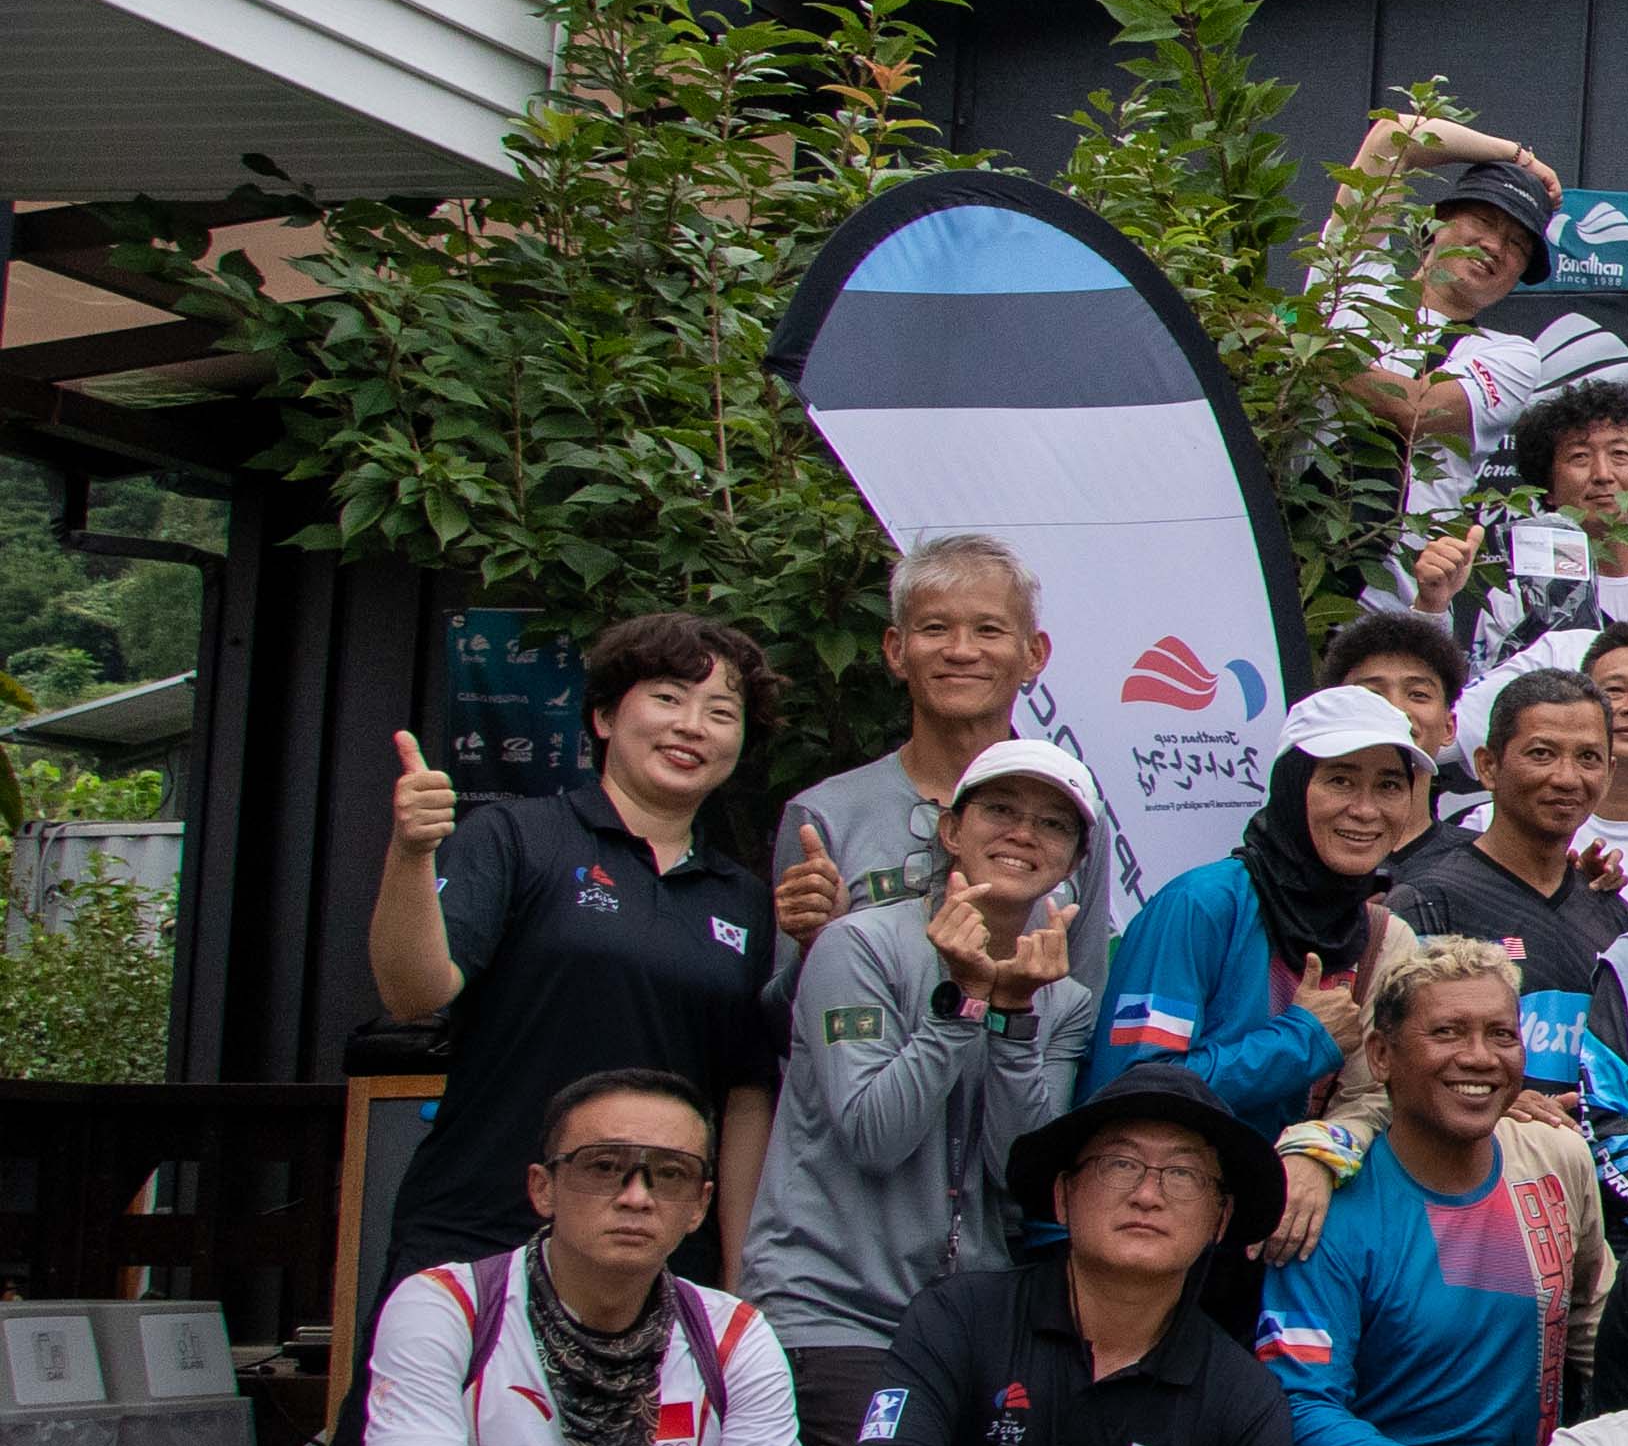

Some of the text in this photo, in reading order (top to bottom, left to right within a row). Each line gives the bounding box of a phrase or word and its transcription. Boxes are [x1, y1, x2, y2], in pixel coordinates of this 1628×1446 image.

[1556, 252, 1623, 277] Jonathan
[1556, 273, 1622, 286] Since 1988
